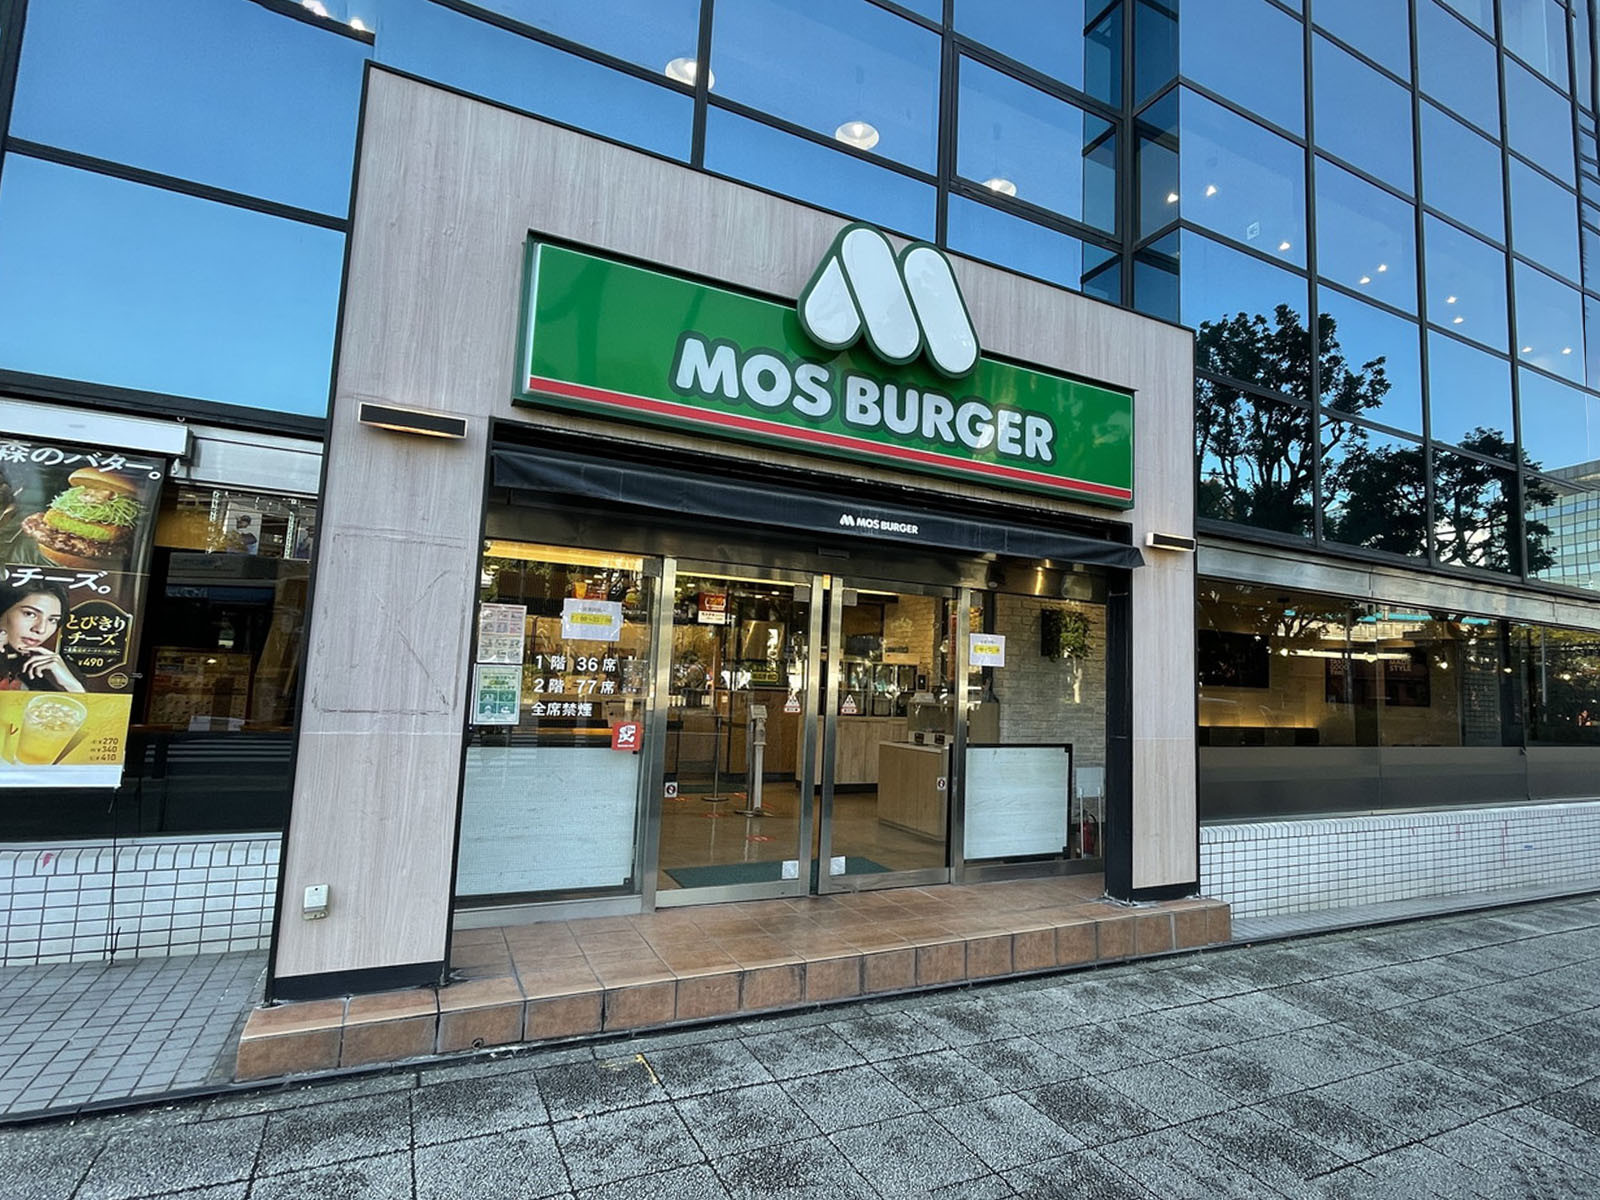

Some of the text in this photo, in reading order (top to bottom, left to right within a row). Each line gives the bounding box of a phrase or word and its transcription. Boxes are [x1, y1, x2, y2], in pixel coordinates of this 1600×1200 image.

[675, 337, 1053, 461] MOS BURGER
[856, 517, 880, 530] MOS
[880, 520, 919, 535] BURGER
[66, 614, 126, 632] とびきり
[67, 631, 119, 646] チーズ
[531, 702, 593, 717] 全席禁煙
